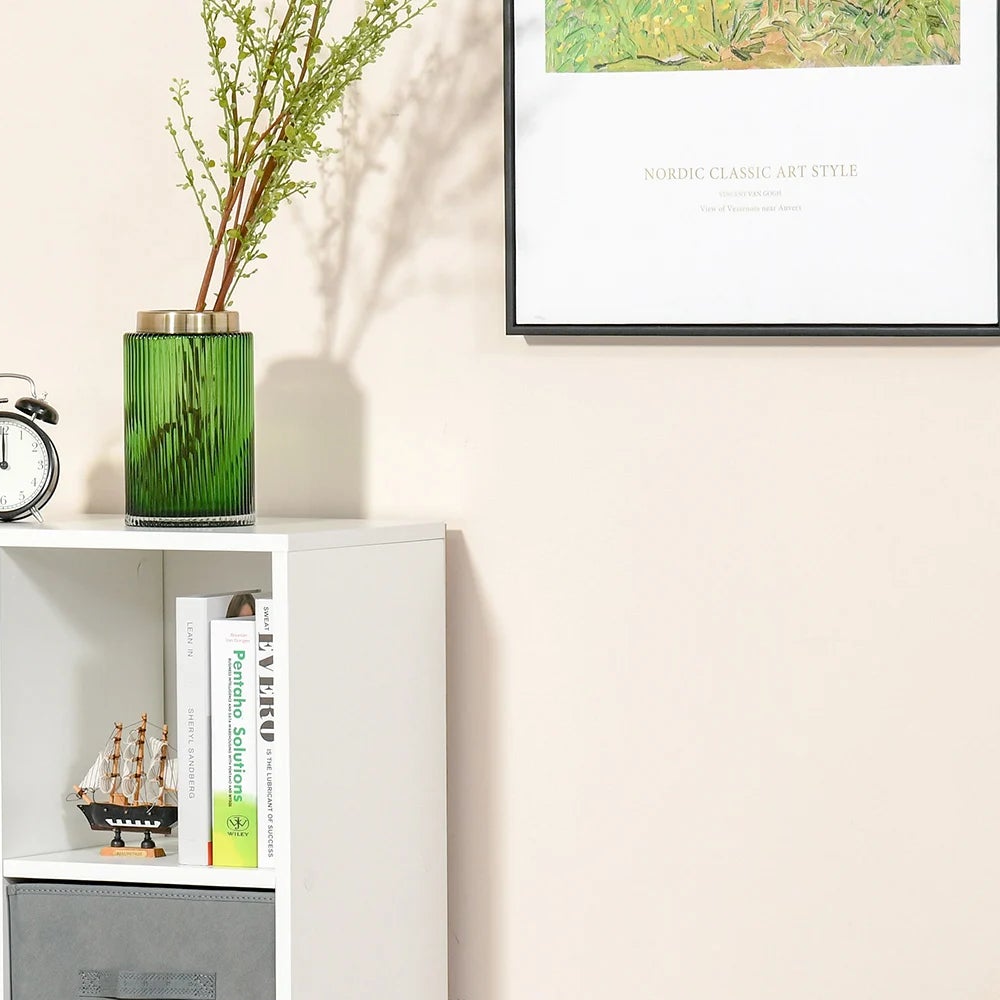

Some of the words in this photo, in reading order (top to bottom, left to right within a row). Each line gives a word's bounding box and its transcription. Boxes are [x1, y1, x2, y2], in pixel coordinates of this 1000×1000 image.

[644, 166, 705, 181] NORDIC
[709, 166, 771, 180] CLASSIC
[776, 164, 807, 179] ART
[811, 164, 858, 178] STYLE
[0, 425, 10, 436] 12
[31, 442, 38, 453] 2
[37, 460, 44, 470] 3
[30, 477, 37, 487] 4
[0, 495, 8, 506] 6
[18, 490, 26, 501] 5
[187, 648, 194, 658] IN
[232, 650, 247, 719] Pentaho
[187, 708, 195, 745] SHERYL
[265, 748, 272, 756] IS
[232, 727, 247, 803] Solutions
[267, 813, 274, 823] OF
